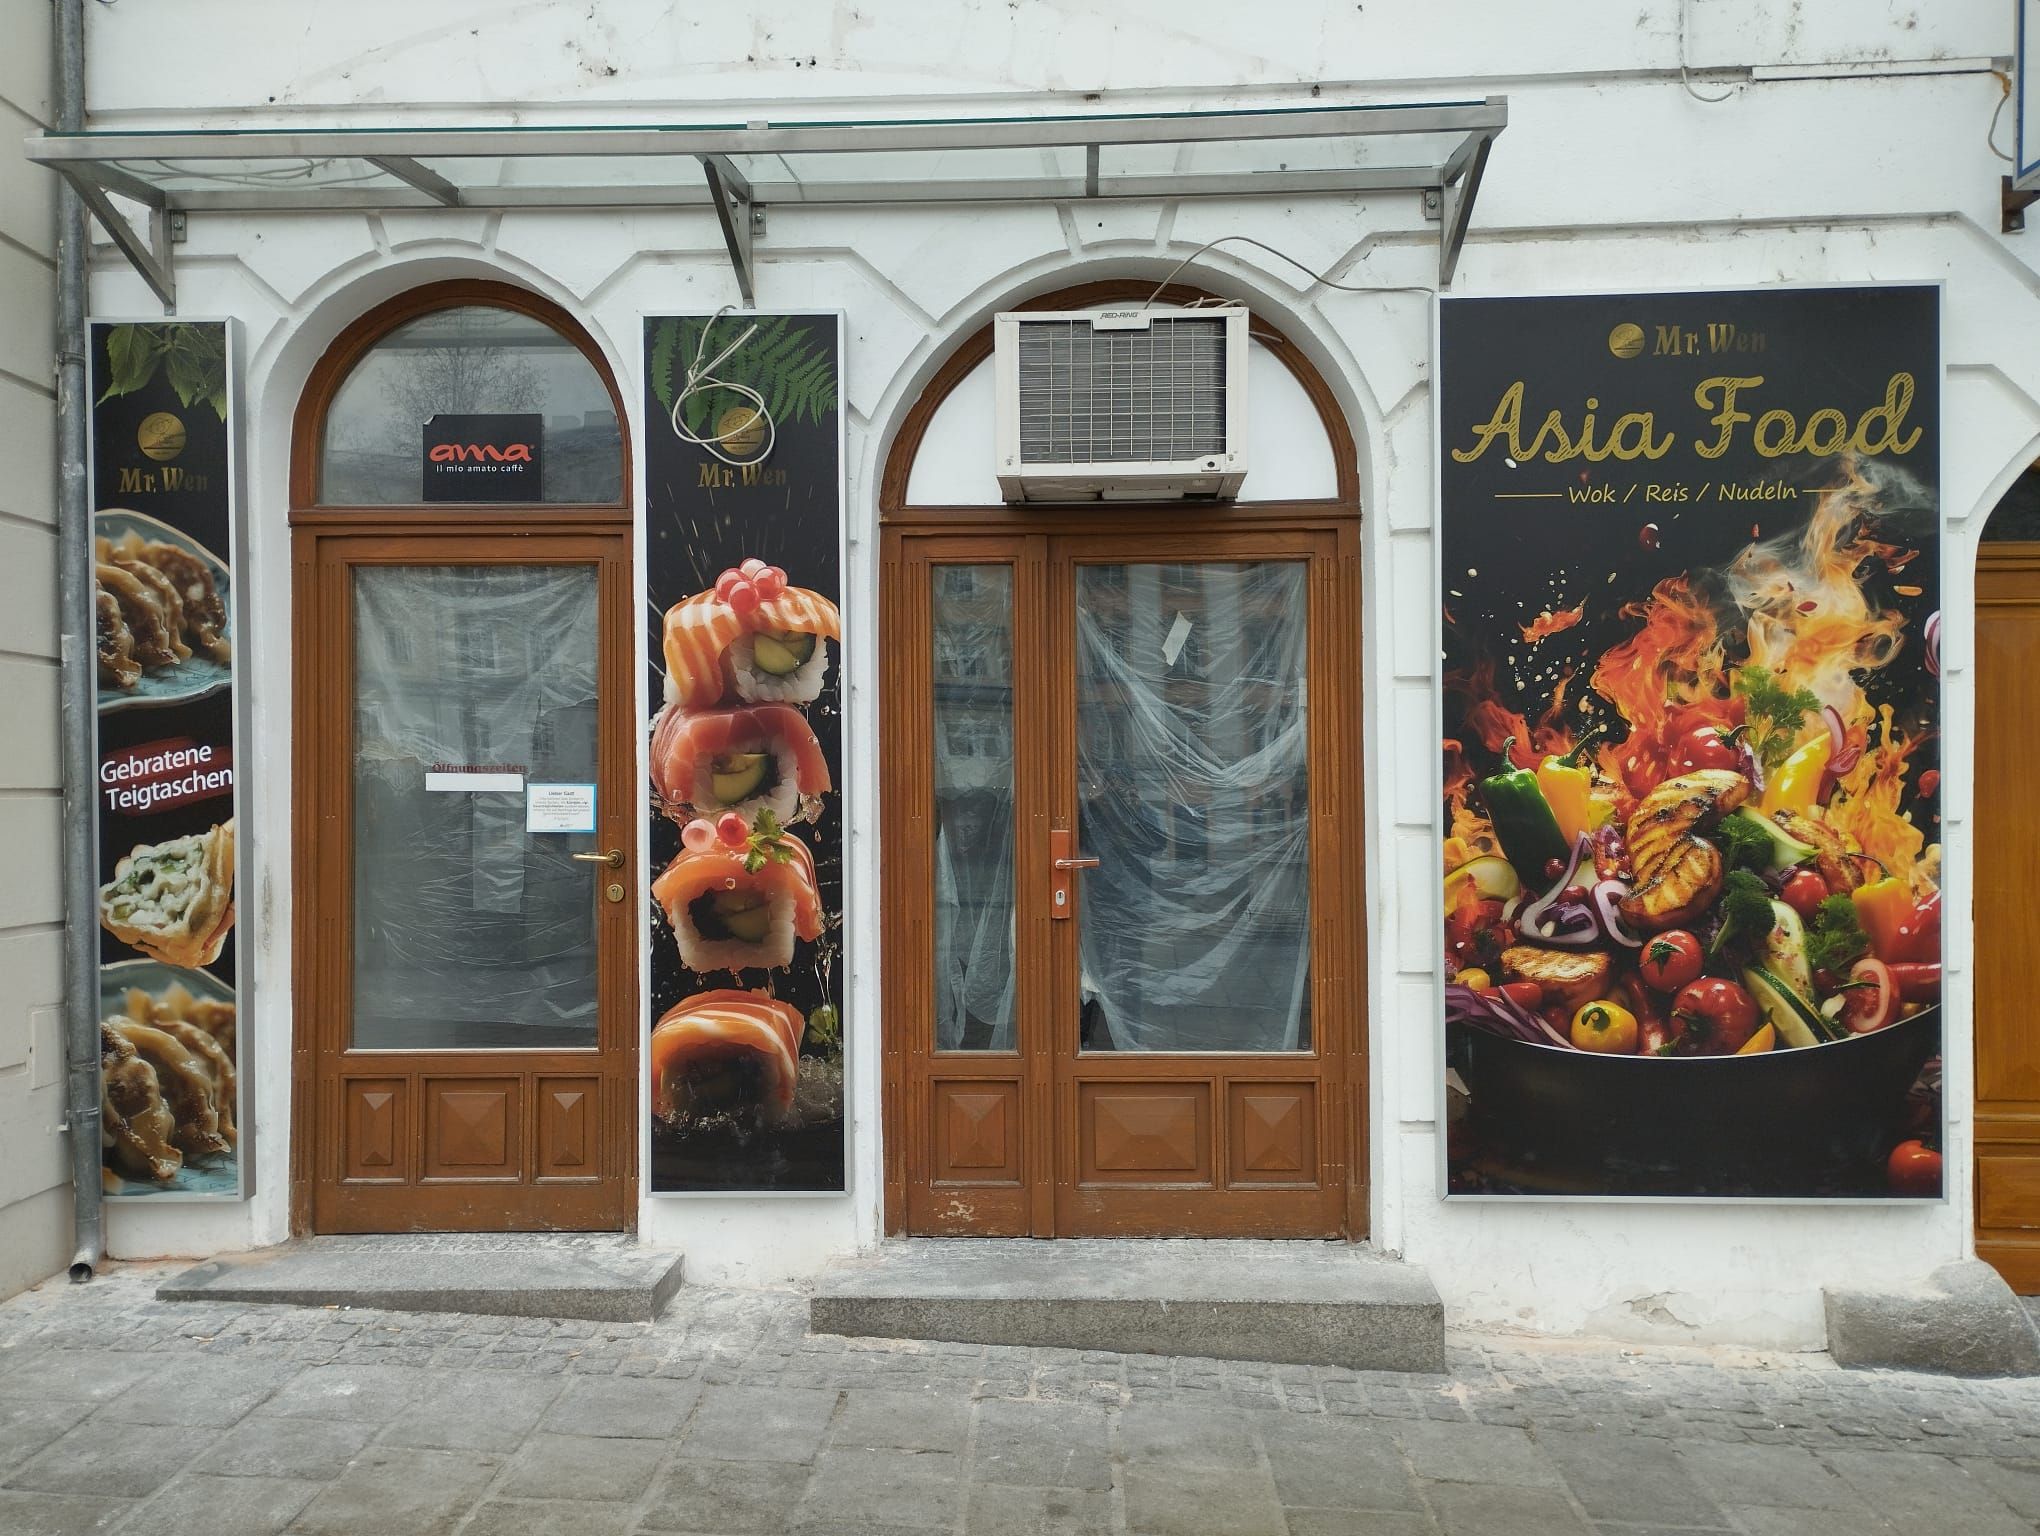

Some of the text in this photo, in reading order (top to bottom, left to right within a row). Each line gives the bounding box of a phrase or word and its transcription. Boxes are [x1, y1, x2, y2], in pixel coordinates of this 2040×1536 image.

[1652, 323, 1768, 356] Mr. Wen
[1451, 372, 1922, 463] Asia Food
[429, 443, 533, 462] ama
[119, 467, 208, 493] Mr. Wen
[446, 464, 464, 472] mio
[500, 463, 524, 472] caffè
[698, 463, 787, 488] Mr. Wen
[1568, 485, 1616, 504] Wok
[1645, 484, 1688, 503] Reis
[1718, 479, 1798, 501] Nudeln
[100, 745, 212, 783] Gebratene
[105, 768, 233, 810] Teigtaschen
